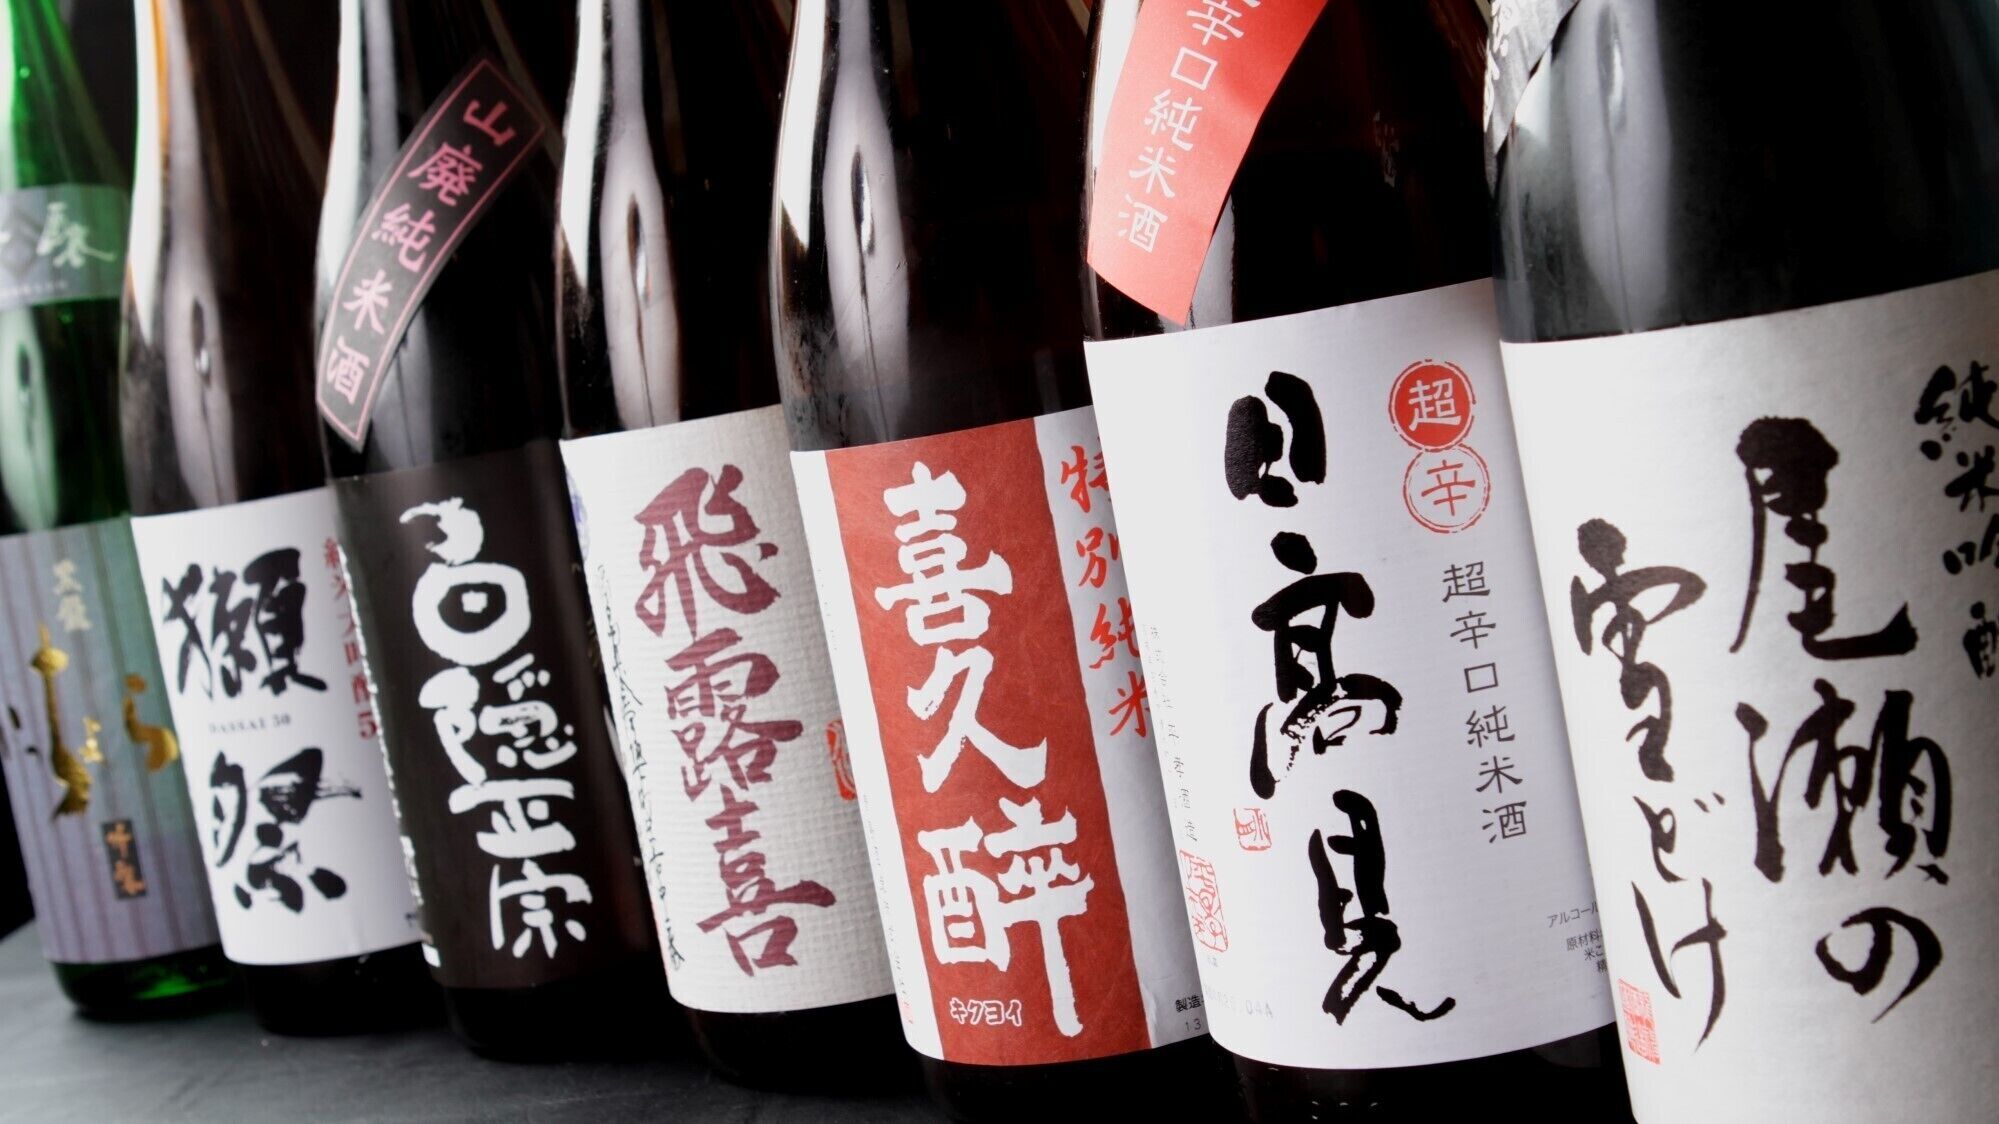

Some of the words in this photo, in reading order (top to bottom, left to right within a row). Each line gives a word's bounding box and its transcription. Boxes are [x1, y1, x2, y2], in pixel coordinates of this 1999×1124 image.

[326, 99, 516, 405] 山廃純米酒
[1118, 0, 1261, 253] 辛口純米酒
[162, 548, 362, 914] 獺祭
[635, 464, 836, 976] 飛露喜
[1442, 561, 1528, 844] 超辛口純米酒
[949, 997, 1022, 1027] キクヨイ
[1175, 994, 1205, 1013] 製造
